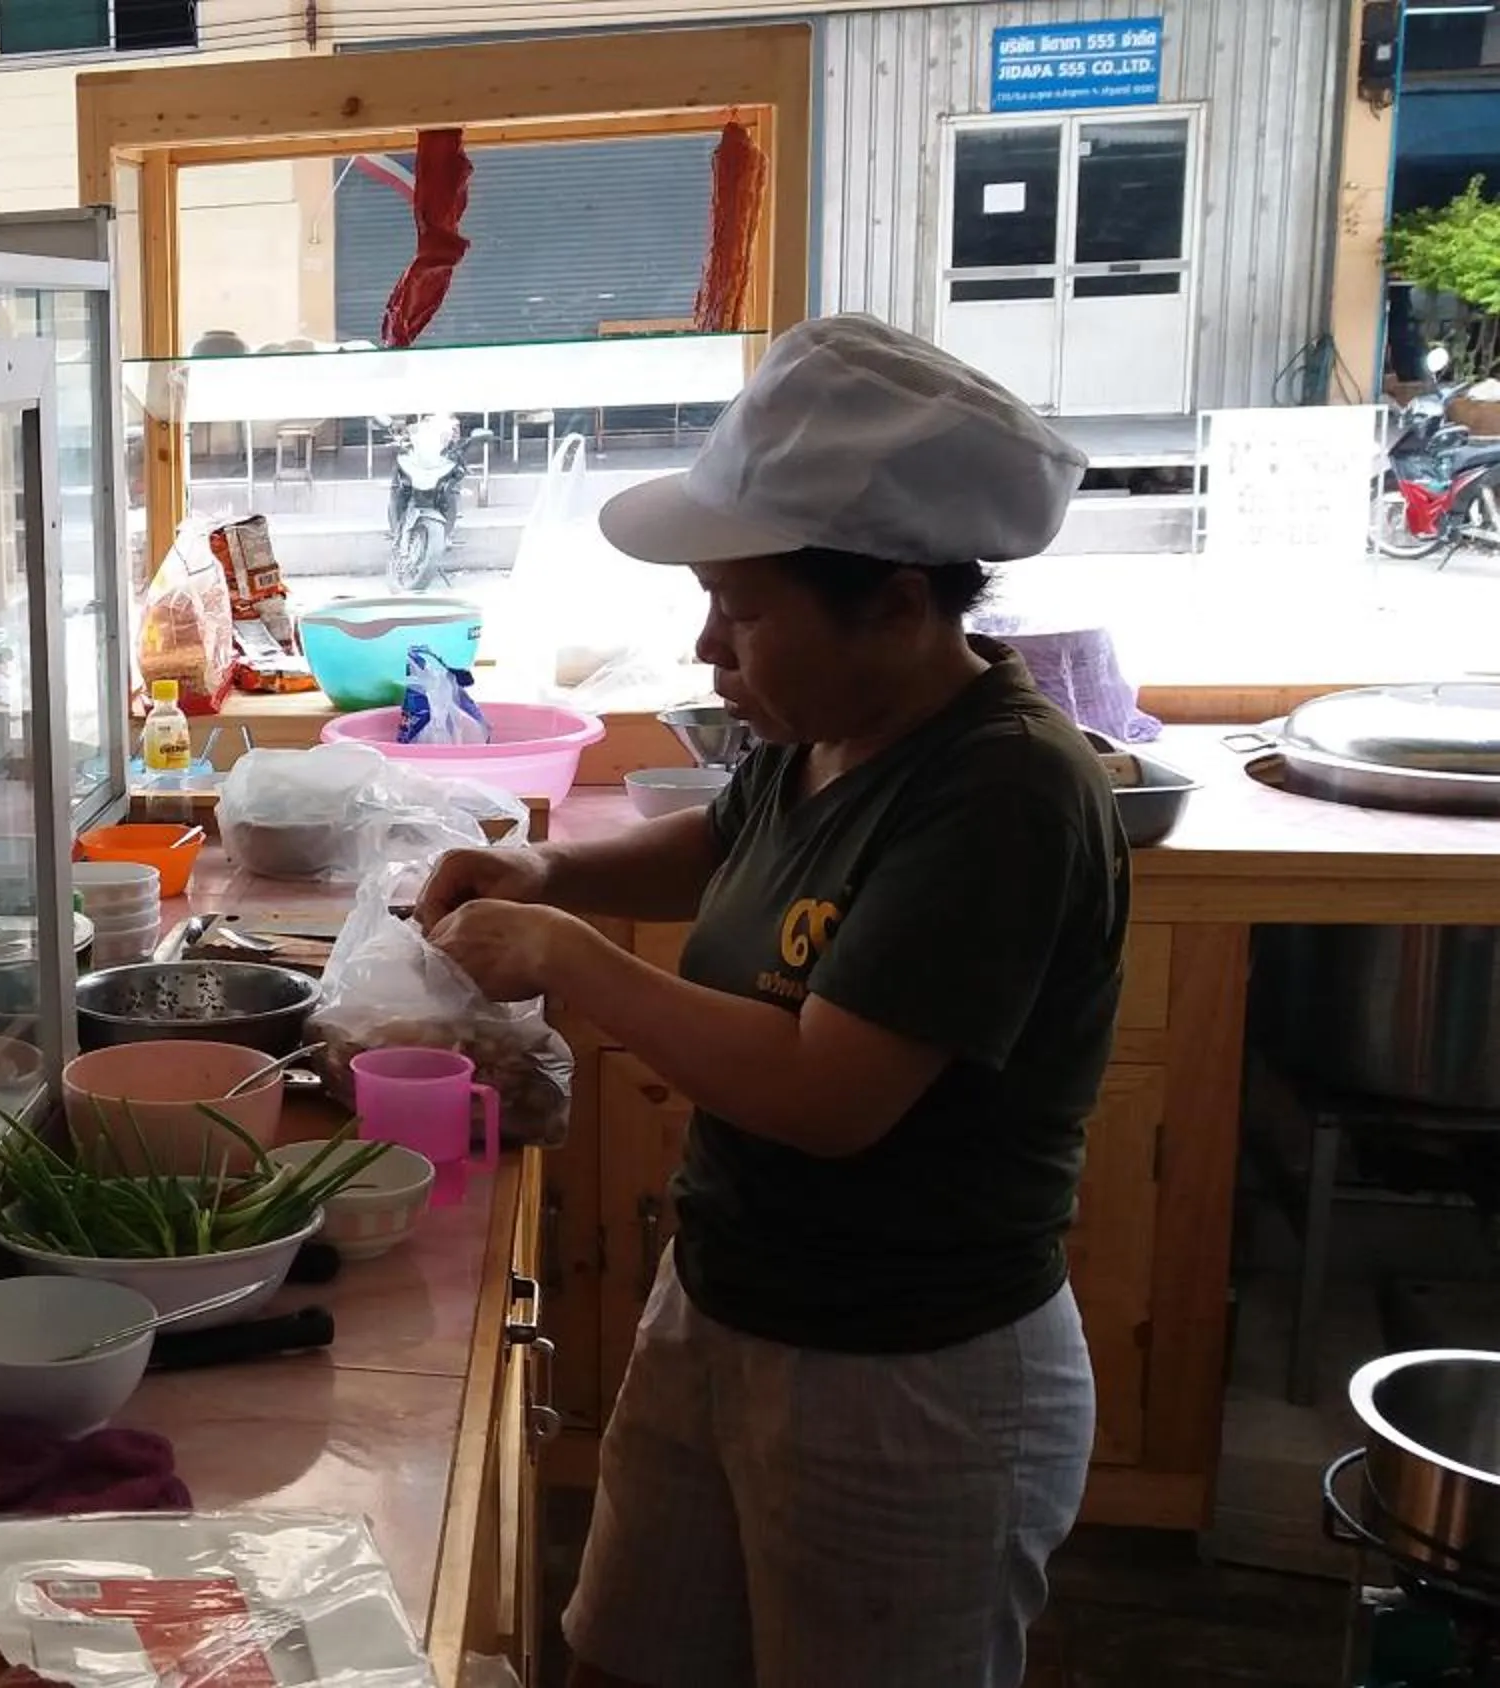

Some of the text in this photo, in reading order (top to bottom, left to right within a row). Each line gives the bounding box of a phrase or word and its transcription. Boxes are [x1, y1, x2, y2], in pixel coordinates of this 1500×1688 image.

[1087, 32, 1116, 50] 555
[998, 64, 1053, 80] JIDAPA
[1058, 62, 1086, 77] 555
